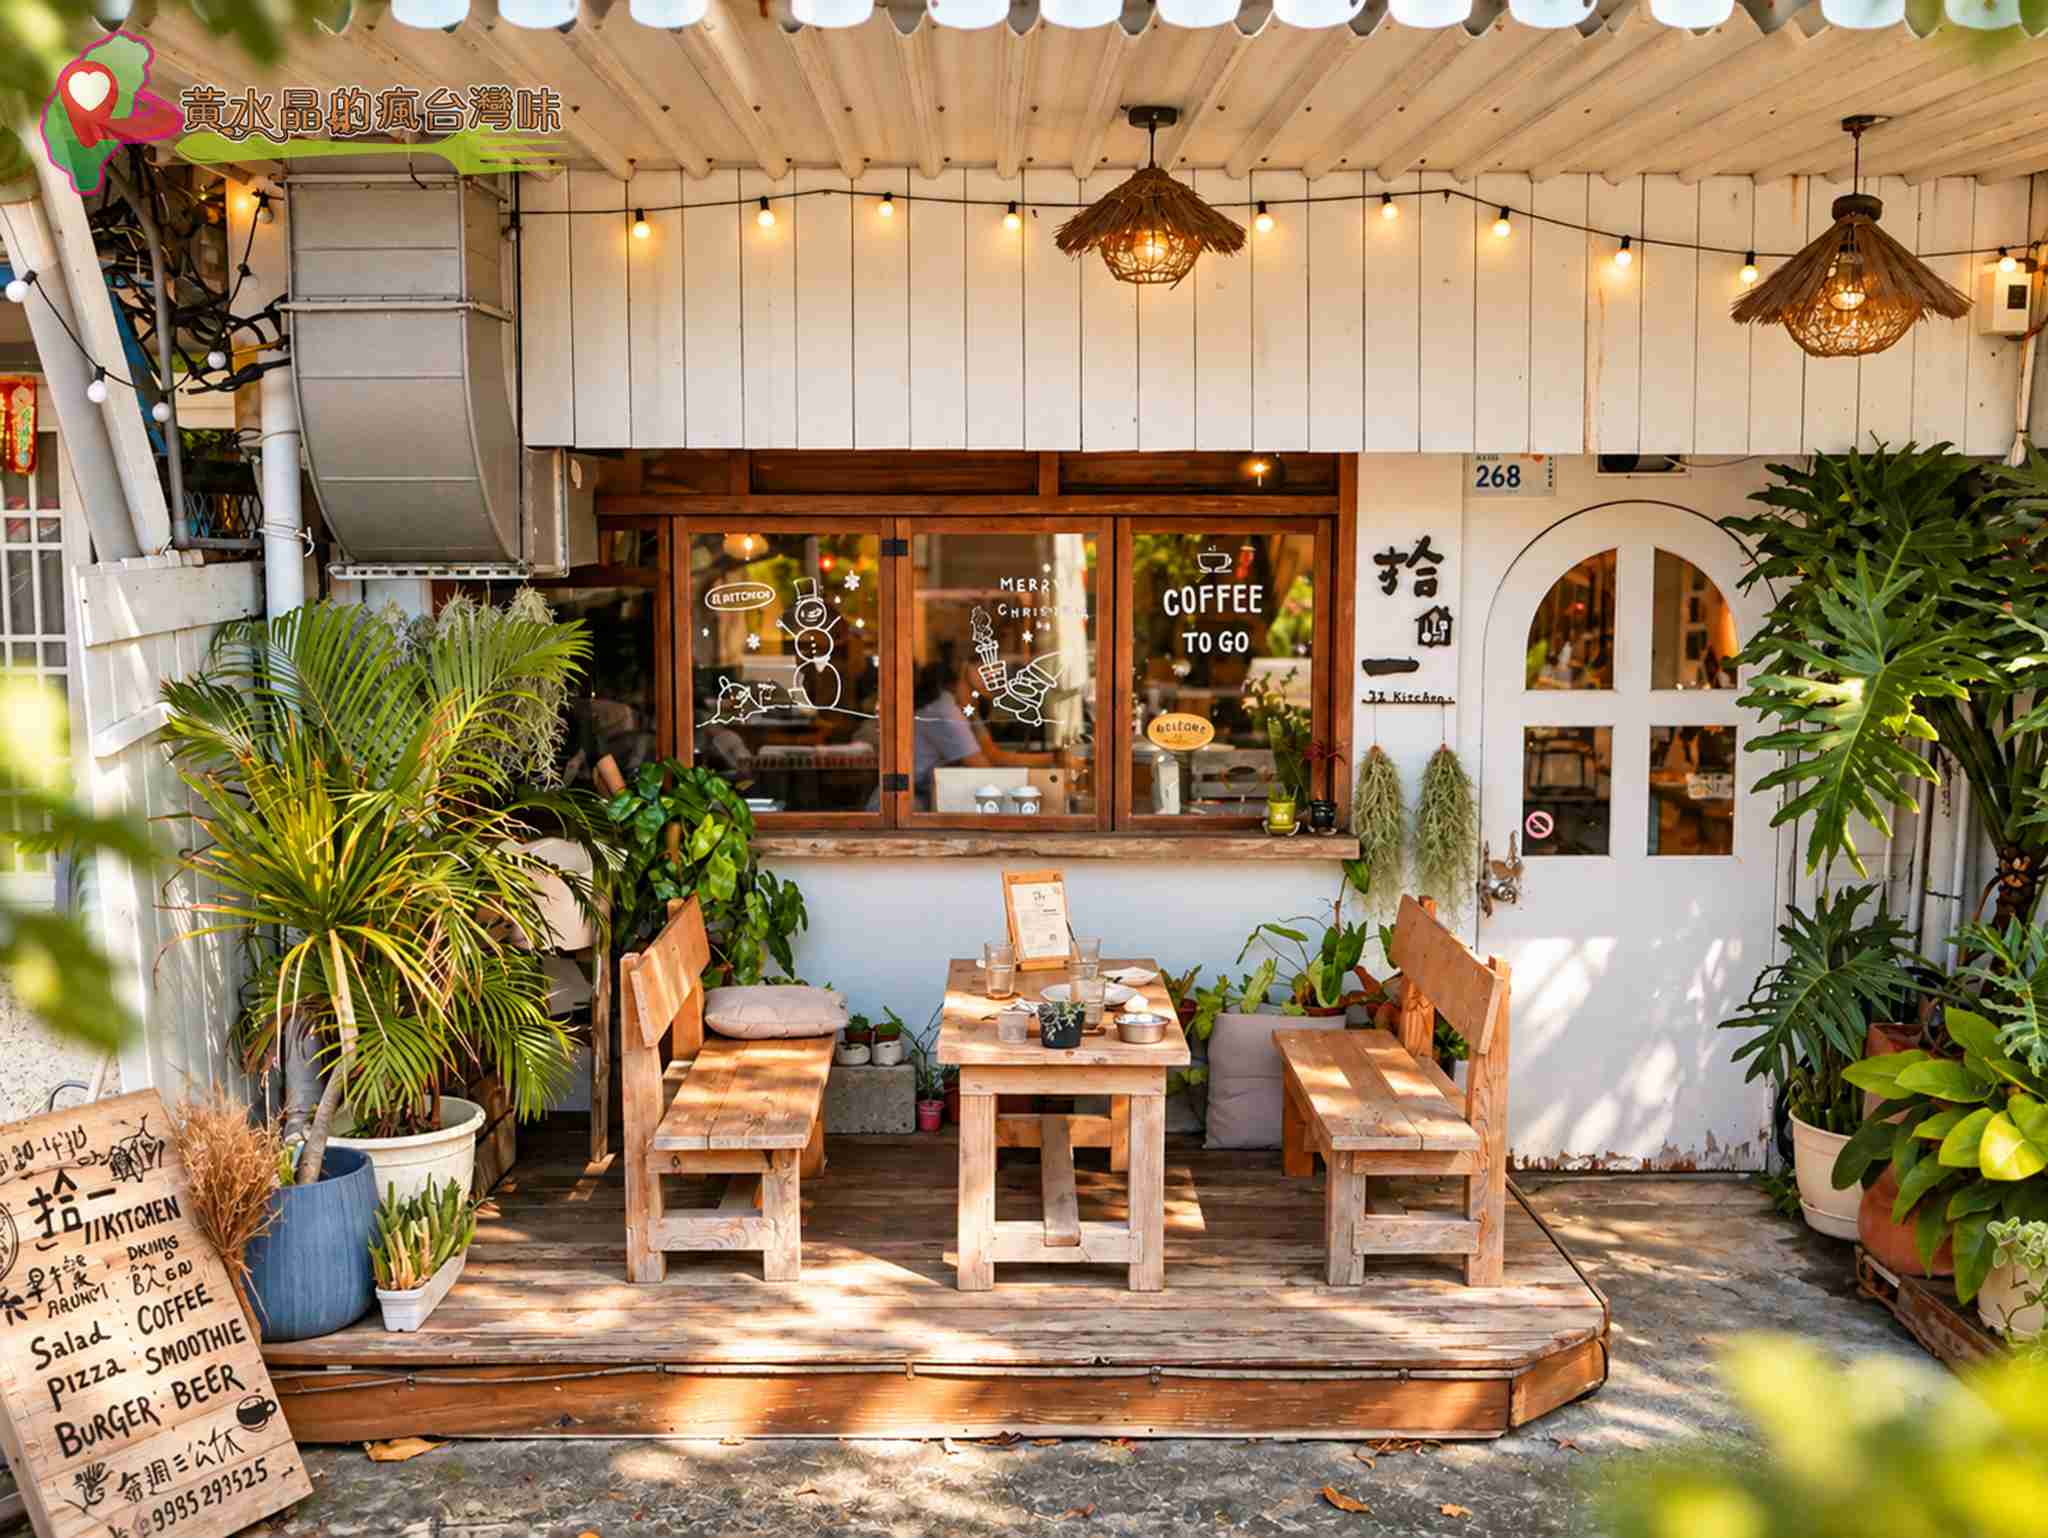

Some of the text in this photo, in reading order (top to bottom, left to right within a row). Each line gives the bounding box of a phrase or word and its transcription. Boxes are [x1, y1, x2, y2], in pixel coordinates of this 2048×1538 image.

[1476, 464, 1521, 488] 268
[1000, 577, 1064, 593] MERR
[1163, 585, 1264, 617] COFFEE
[1182, 631, 1250, 653] TO GO
[30, 1284, 215, 1371] Salad COFFEE
[145, 1318, 247, 1376] SMOOTHIE
[171, 1364, 246, 1411] BEER
